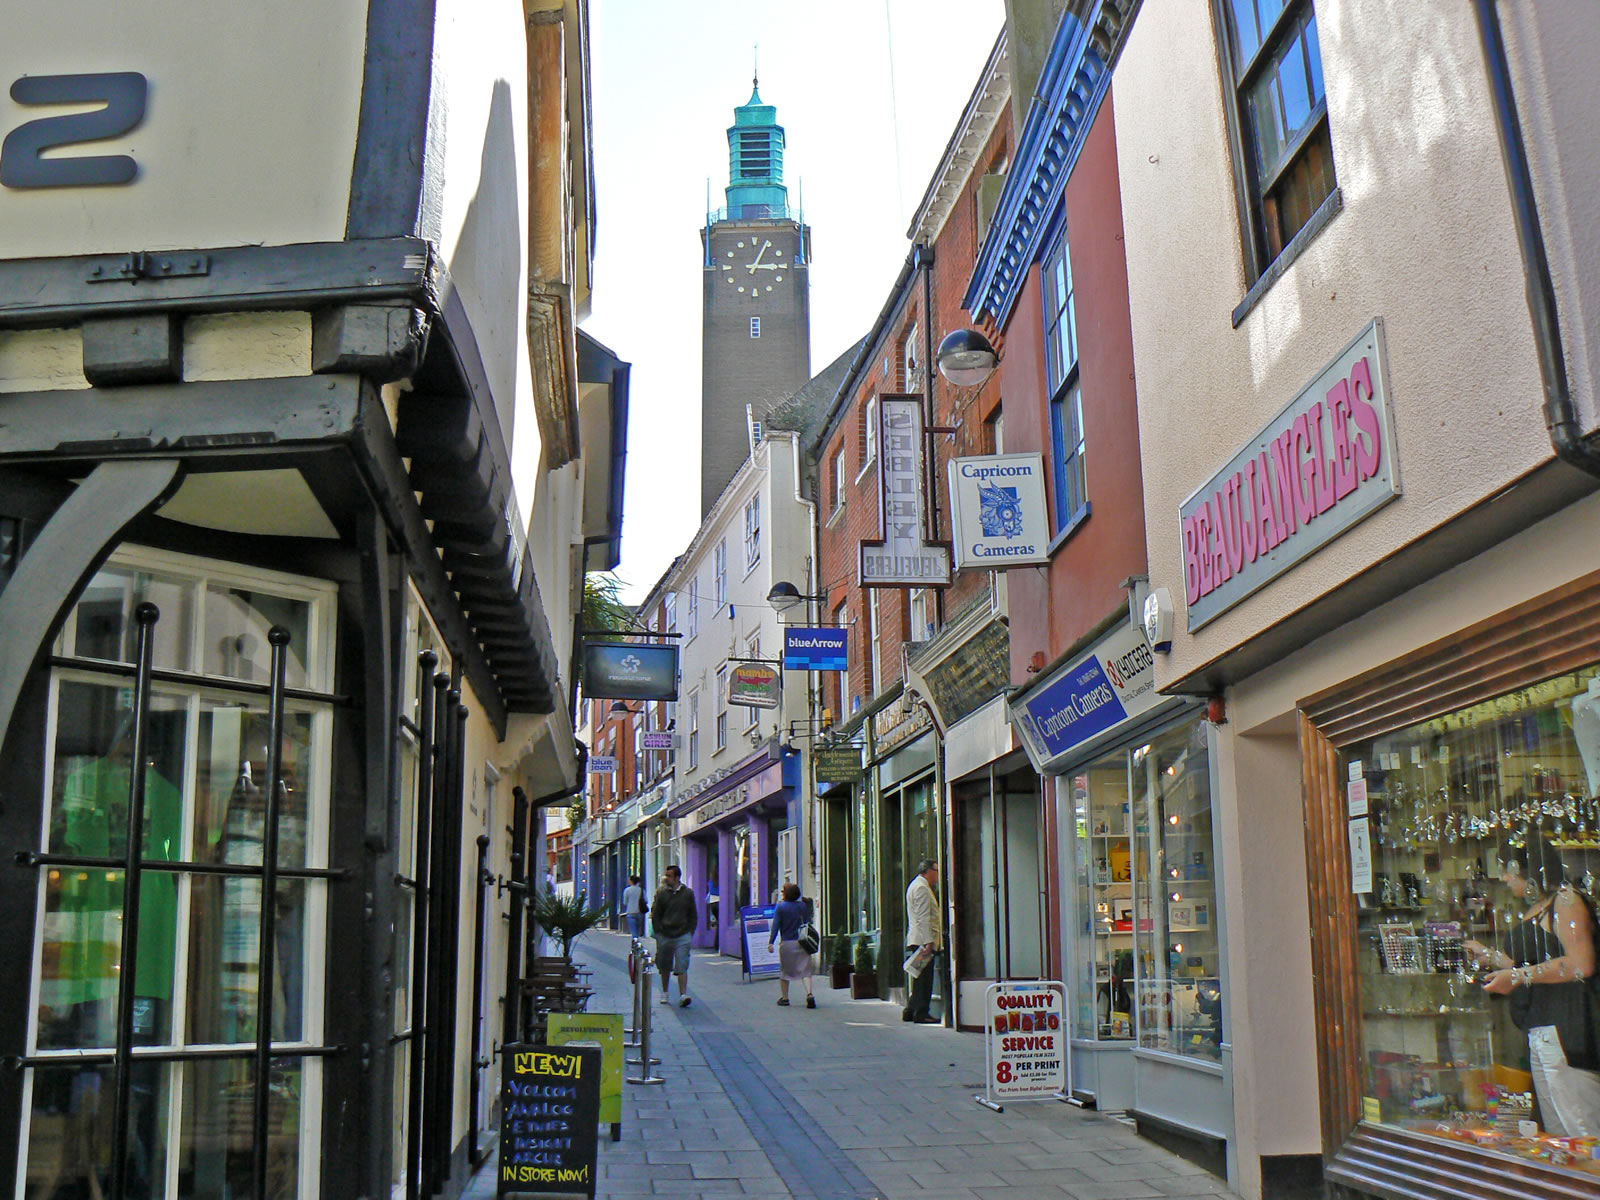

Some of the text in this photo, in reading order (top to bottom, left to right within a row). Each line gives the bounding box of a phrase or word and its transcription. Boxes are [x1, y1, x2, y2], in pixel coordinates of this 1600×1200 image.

[961, 464, 1033, 480] Capricorn
[1182, 357, 1382, 607] BEAUJANGLES
[972, 543, 1035, 557] Cameras
[788, 637, 843, 648] blueArrow
[1113, 642, 1154, 682] KYOCERA
[736, 668, 776, 678] mambo
[1036, 682, 1113, 741] Capricorn Cameras
[644, 740, 672, 748] GIRLS
[997, 993, 1054, 1010] QUALITY
[995, 1011, 1059, 1033] PHOTO
[1002, 1036, 1054, 1052] SERVICE
[514, 1052, 582, 1079] NEW!
[1016, 1062, 1032, 1071] PER
[1034, 1060, 1060, 1070] PRINT
[508, 1079, 577, 1099] VOLCOM
[503, 1164, 589, 1184] IN STORE NOW!
